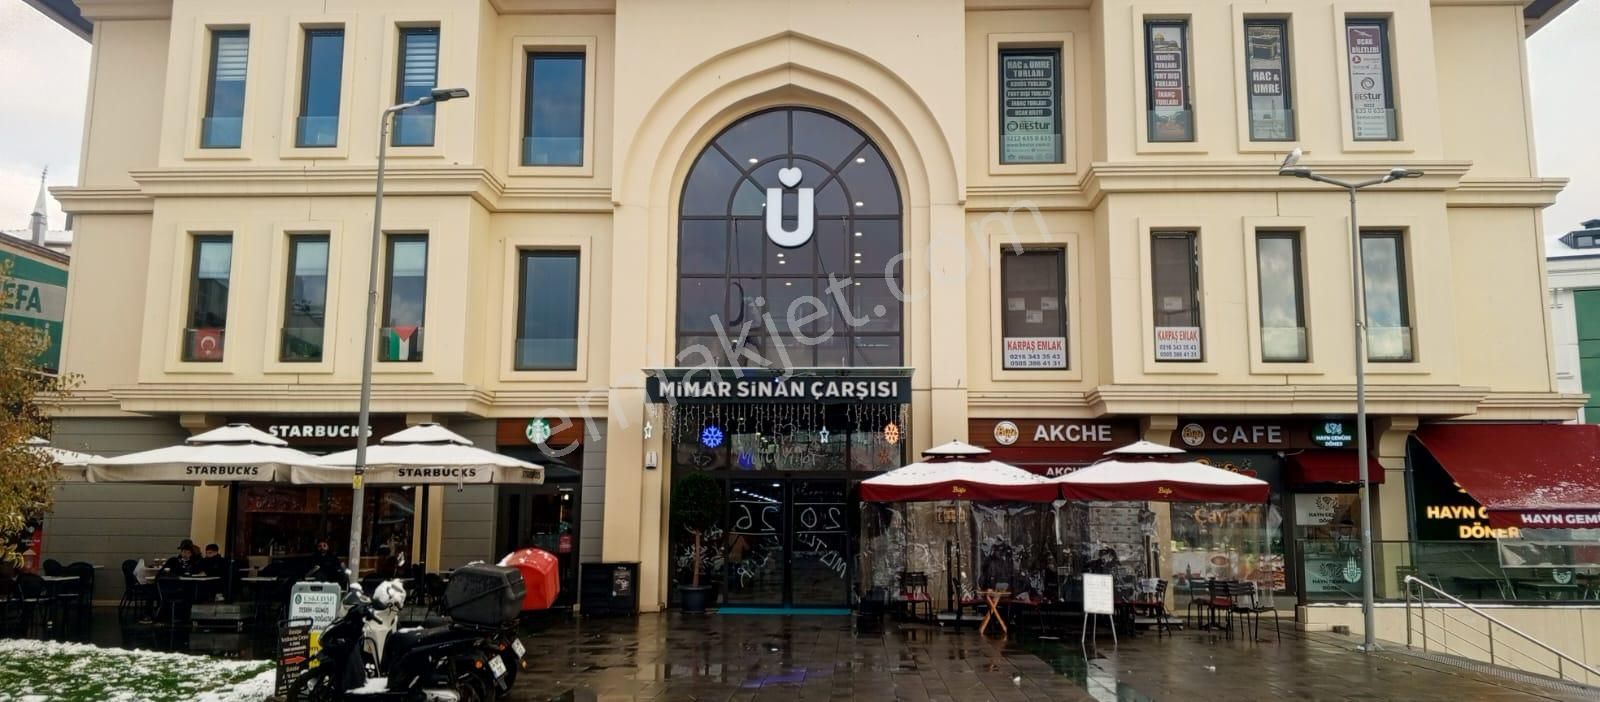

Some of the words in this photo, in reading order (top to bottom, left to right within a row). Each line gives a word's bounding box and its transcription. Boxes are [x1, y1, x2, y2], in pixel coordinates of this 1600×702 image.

[1253, 83, 1280, 94] UMRE
[1007, 341, 1036, 353] KARPAŞ
[1037, 341, 1062, 351] EMLAK
[811, 381, 898, 400] ÇARŞISI
[269, 425, 373, 437] STARBUCKS
[1033, 424, 1113, 441] AKCHE
[1212, 425, 1282, 443] CAFE
[186, 466, 259, 475] STARBUCKS
[398, 468, 477, 477] STARBUCKS
[1427, 505, 1475, 519] HAYN
[1521, 514, 1563, 524] HAYN
[1565, 512, 1600, 524] GEM
[1459, 522, 1520, 539] DÖNER
